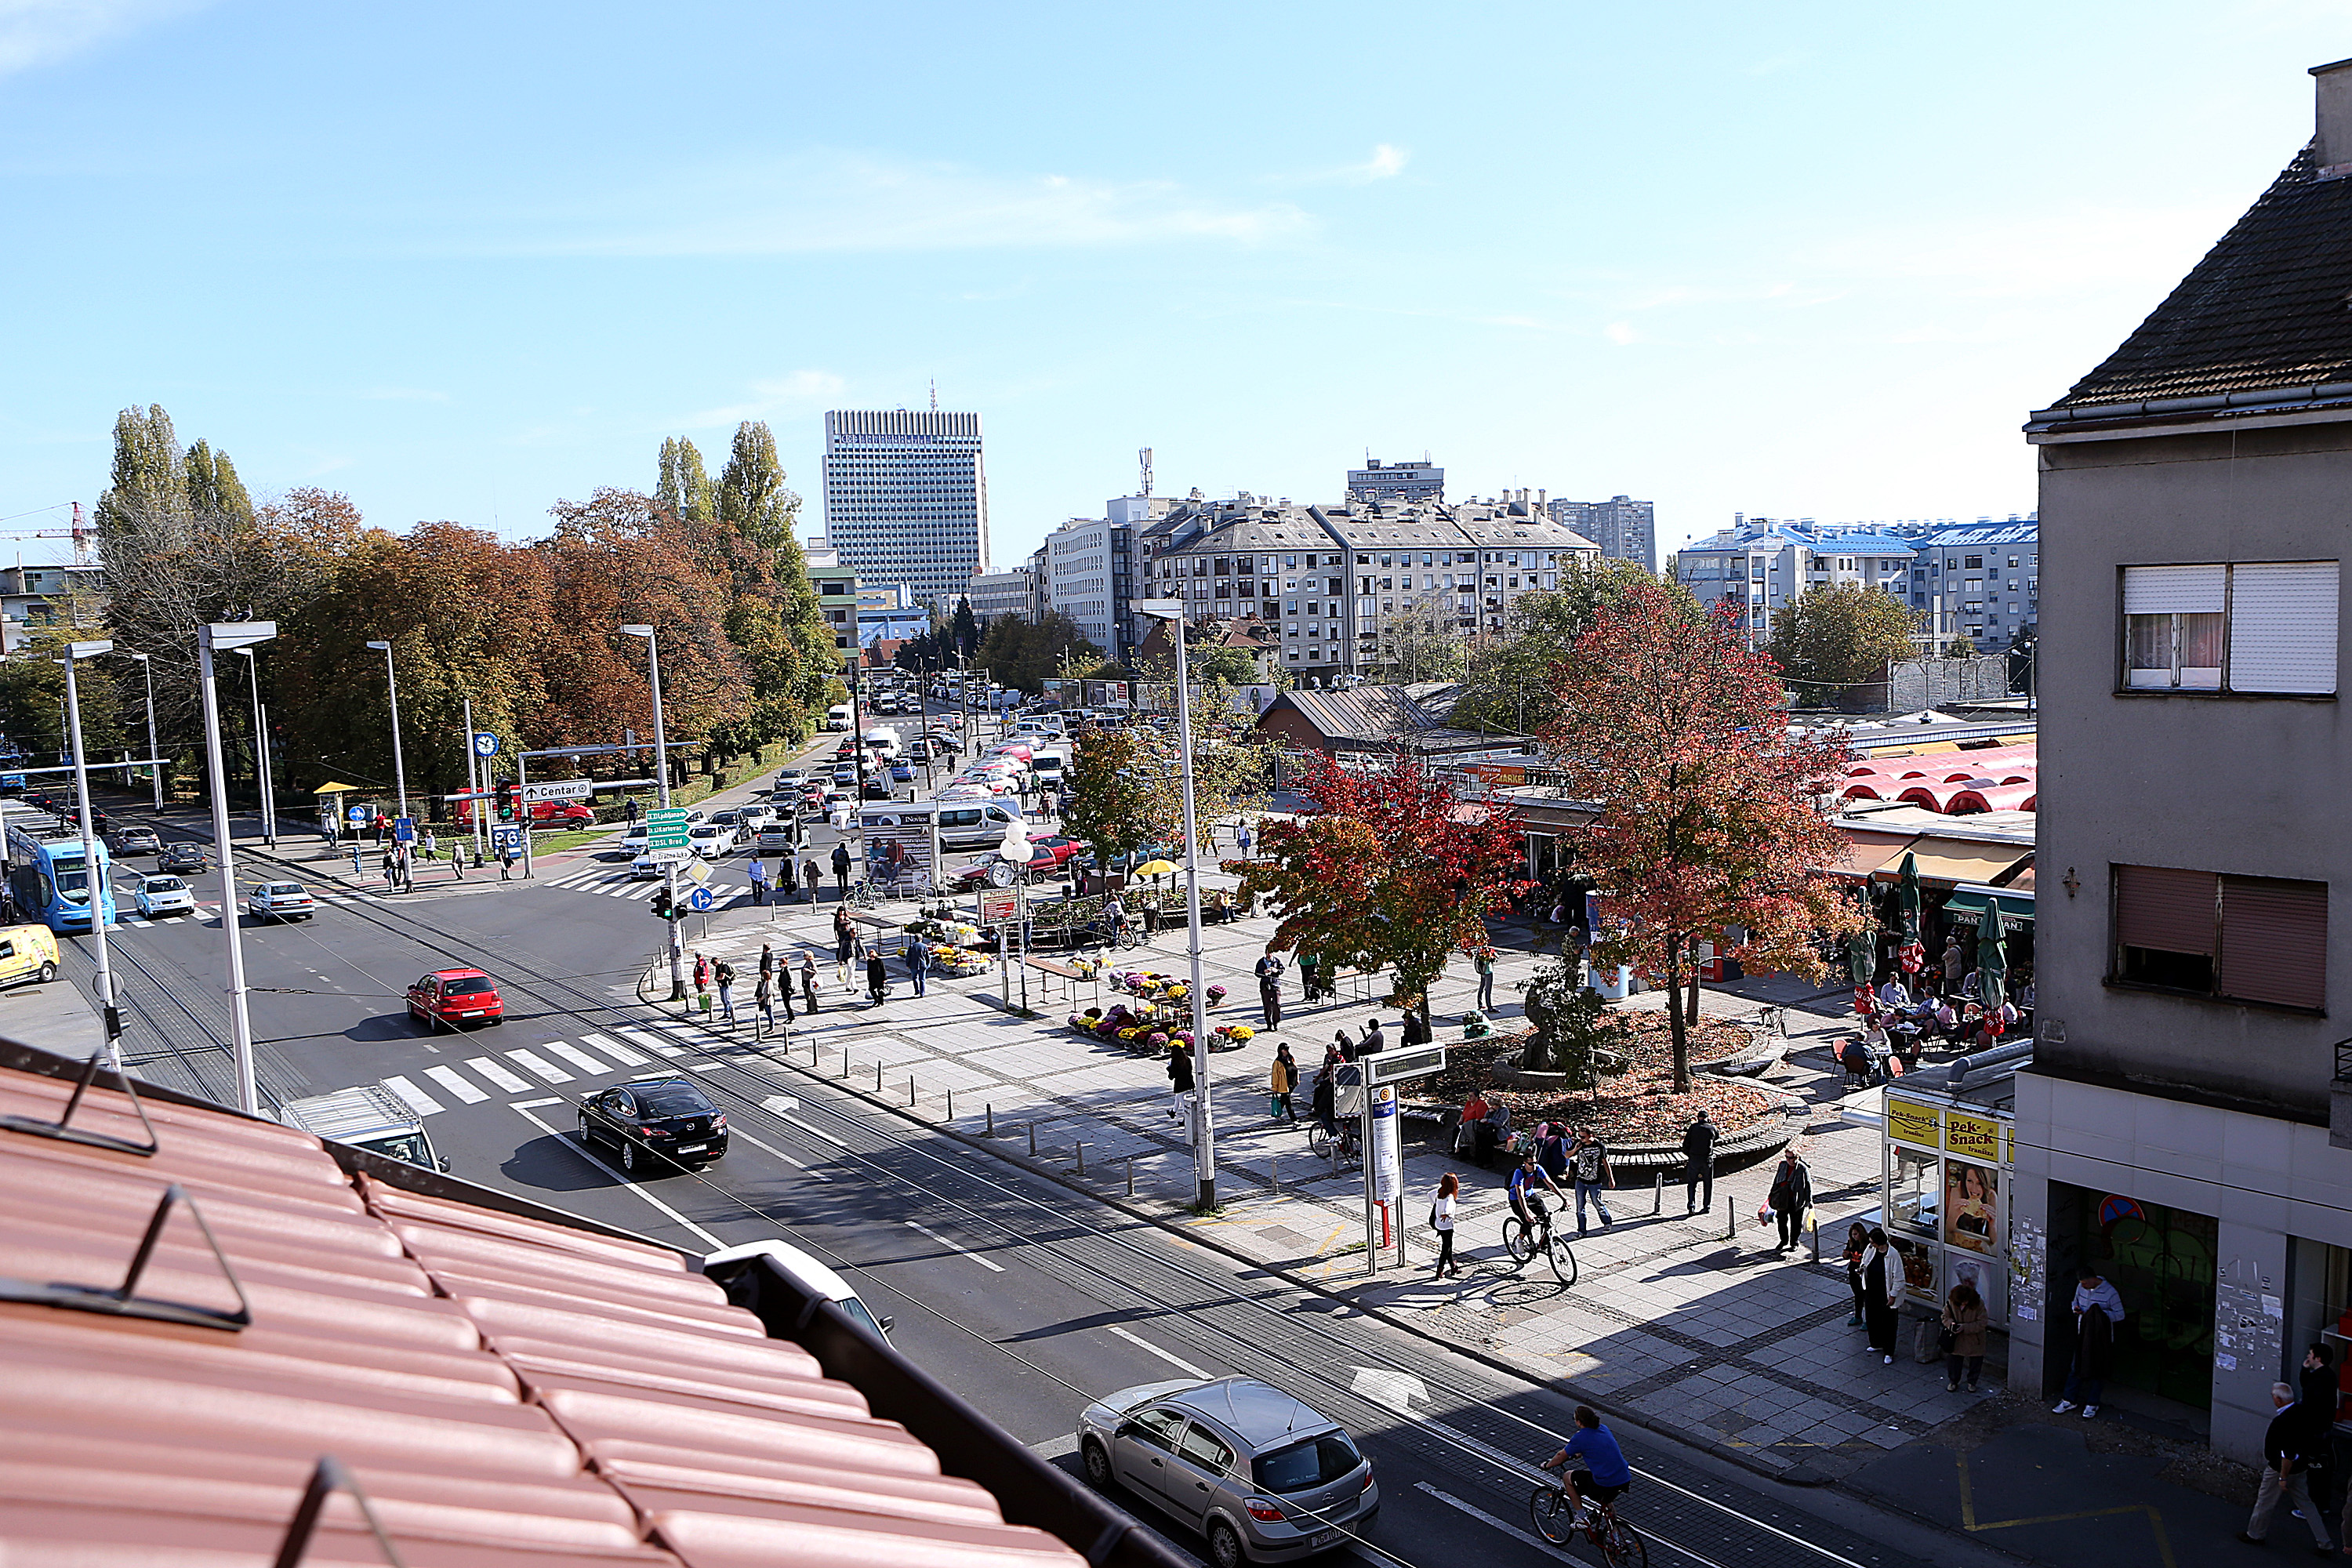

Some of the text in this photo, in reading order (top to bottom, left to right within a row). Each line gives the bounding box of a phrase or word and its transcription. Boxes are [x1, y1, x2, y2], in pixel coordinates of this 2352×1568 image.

[540, 786, 576, 797] Centar
[658, 811, 680, 820] Ljubljana
[1958, 916, 1978, 924] PAN
[1950, 1121, 1981, 1133] Pek-
[1950, 1133, 1994, 1145] Snack
[1316, 1534, 1325, 1544] ZG
